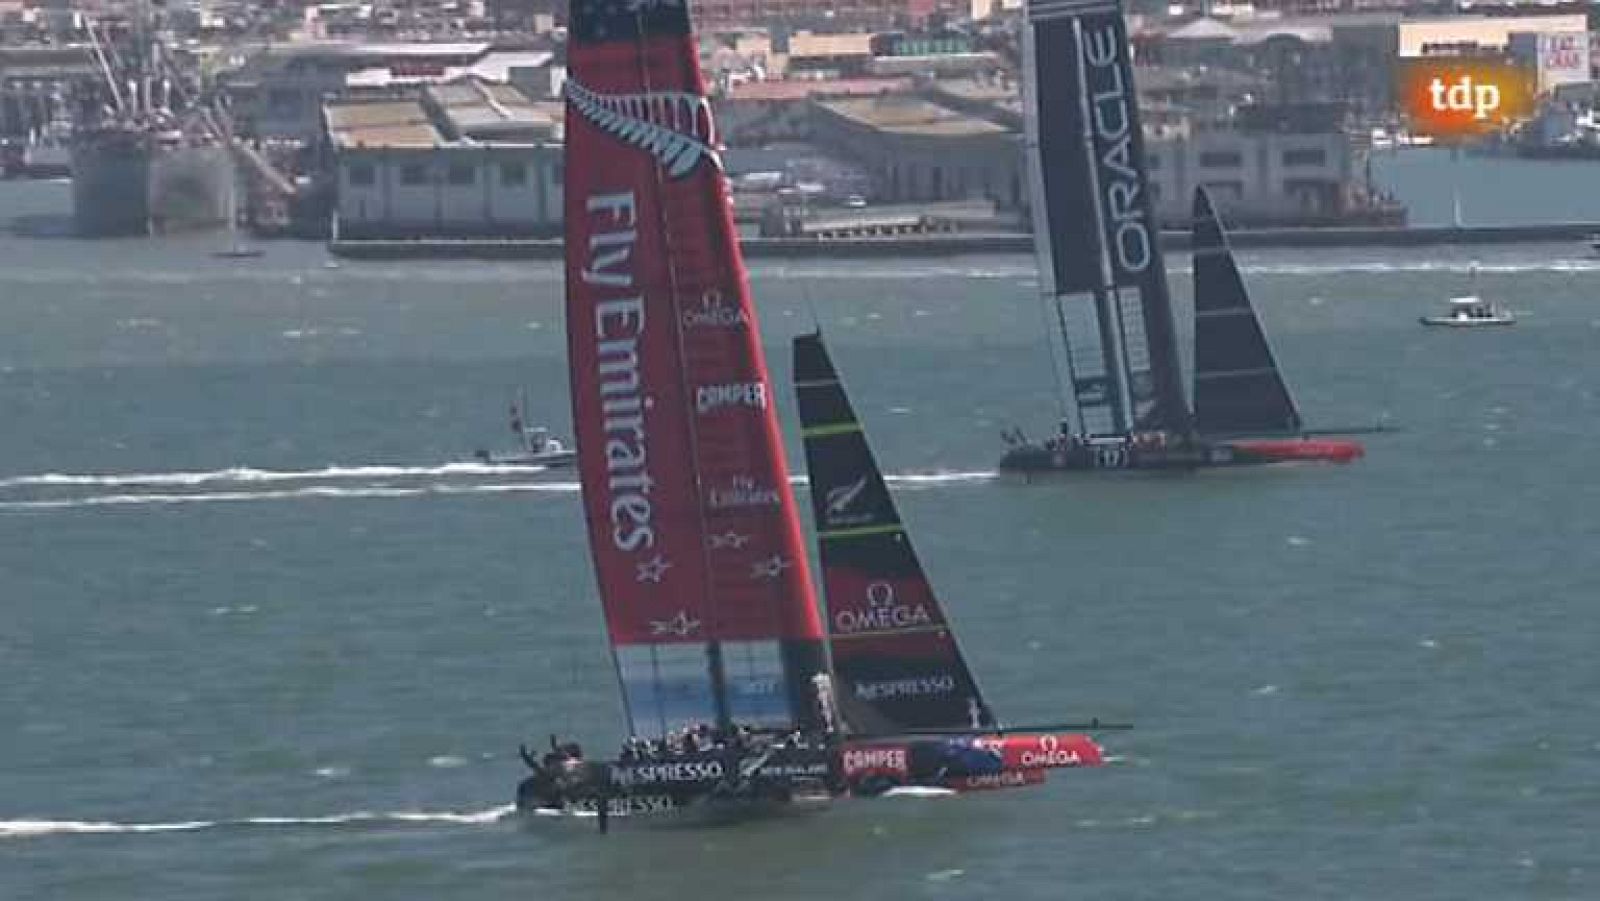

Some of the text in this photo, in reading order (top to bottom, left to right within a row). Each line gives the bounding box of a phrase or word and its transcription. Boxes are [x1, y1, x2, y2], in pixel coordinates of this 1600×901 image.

[1084, 25, 1150, 271] ORACLE
[582, 191, 654, 551] Fly Emirates
[696, 383, 766, 411] CAMPER
[835, 604, 931, 631] OMEGA
[610, 759, 723, 785] NESPRESSO
[843, 750, 907, 772] CAMPER
[1021, 751, 1081, 766] OMEGA
